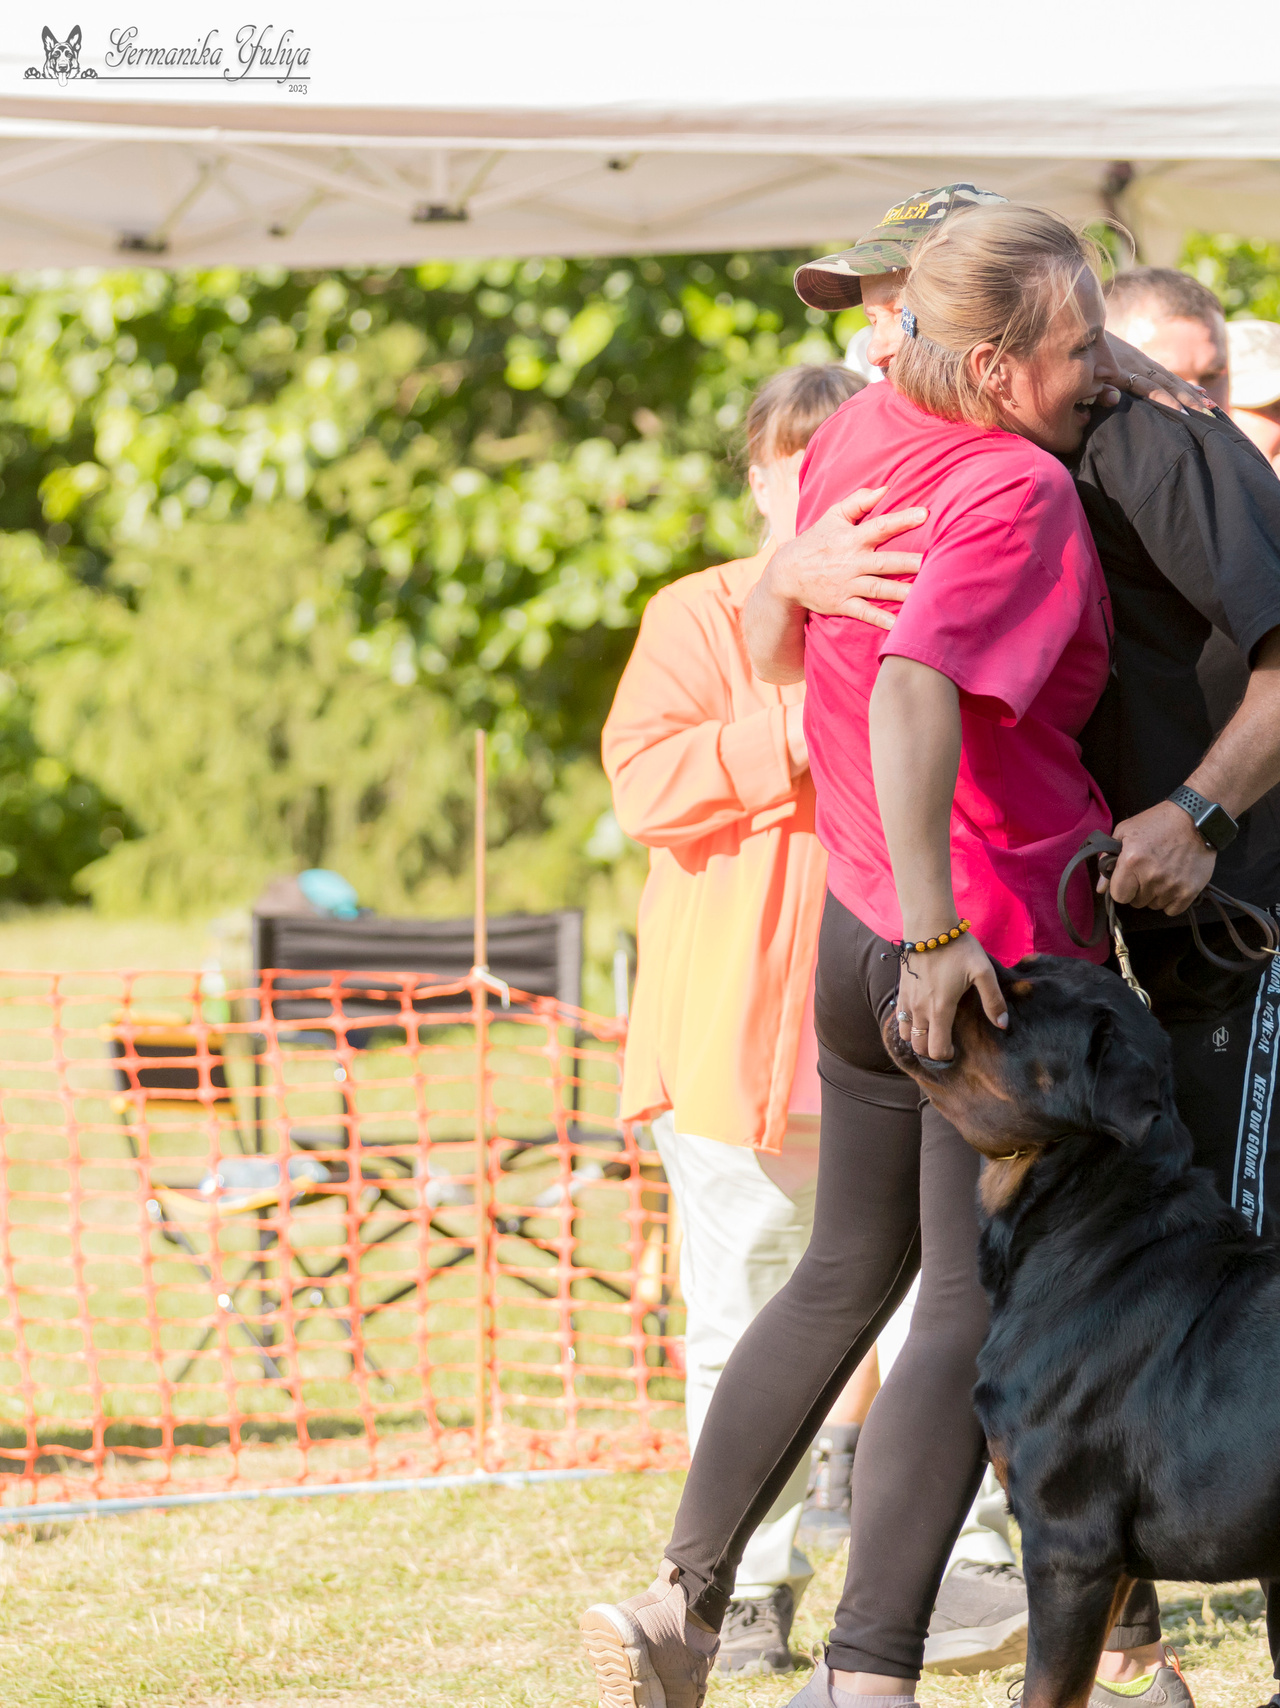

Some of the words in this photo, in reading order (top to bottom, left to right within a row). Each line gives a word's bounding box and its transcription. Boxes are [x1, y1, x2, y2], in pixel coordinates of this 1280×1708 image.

[1257, 1001, 1275, 1054] NEWEAR
[1252, 1073, 1267, 1110] KEEP
[1249, 1110, 1262, 1134] ON
[1243, 1132, 1260, 1180] GOING.
